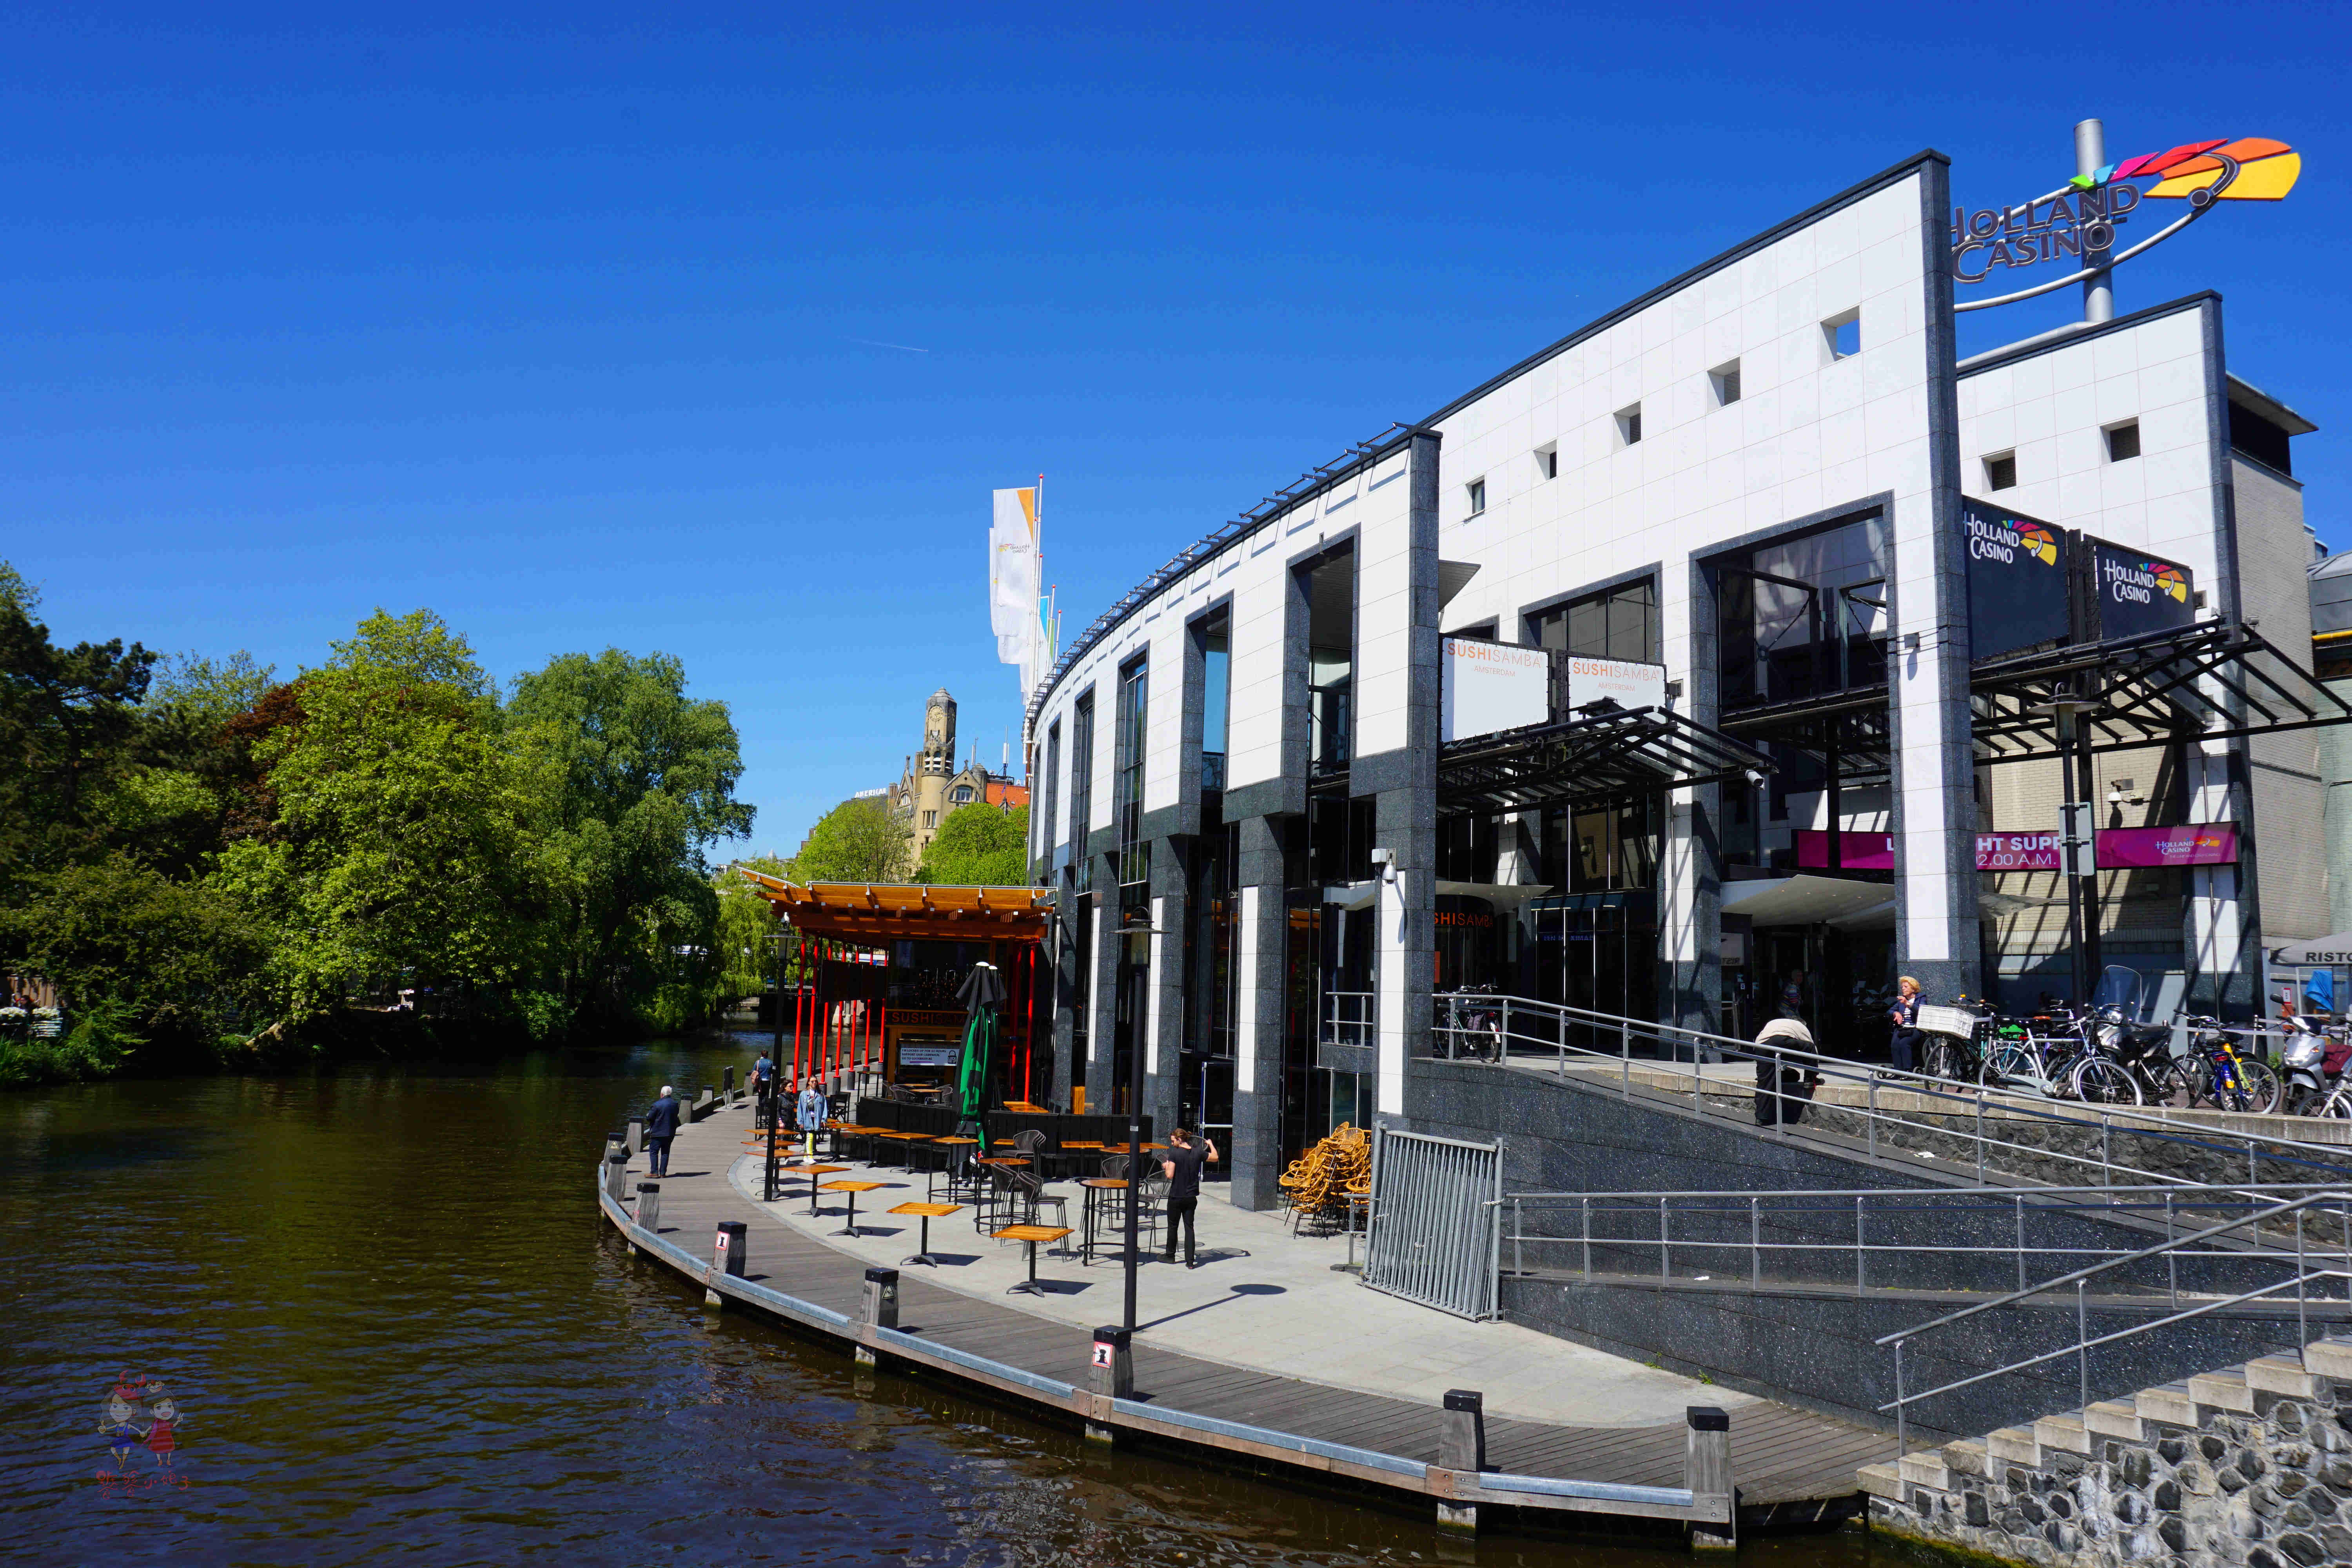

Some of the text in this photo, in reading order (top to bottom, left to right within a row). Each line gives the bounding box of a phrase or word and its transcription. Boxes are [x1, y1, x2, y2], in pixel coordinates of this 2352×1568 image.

[1951, 221, 2116, 284] CASINO
[1963, 511, 2019, 547] HOLLAND
[1971, 536, 2013, 564] CASINO
[2104, 559, 2154, 588] HOLLAND
[2113, 581, 2150, 604] CASINO
[1447, 643, 1541, 668] SUSHISAMBA
[1474, 665, 1515, 677] AMSTERDAM
[1573, 662, 1658, 682] SUSHISAMBA
[1599, 682, 1635, 691] AMSTERDAM
[1976, 838, 2004, 851] HT
[2155, 841, 2194, 849] HOLLAND
[2161, 847, 2190, 855] CASINO
[1976, 853, 2056, 866] 2.00 A.M.
